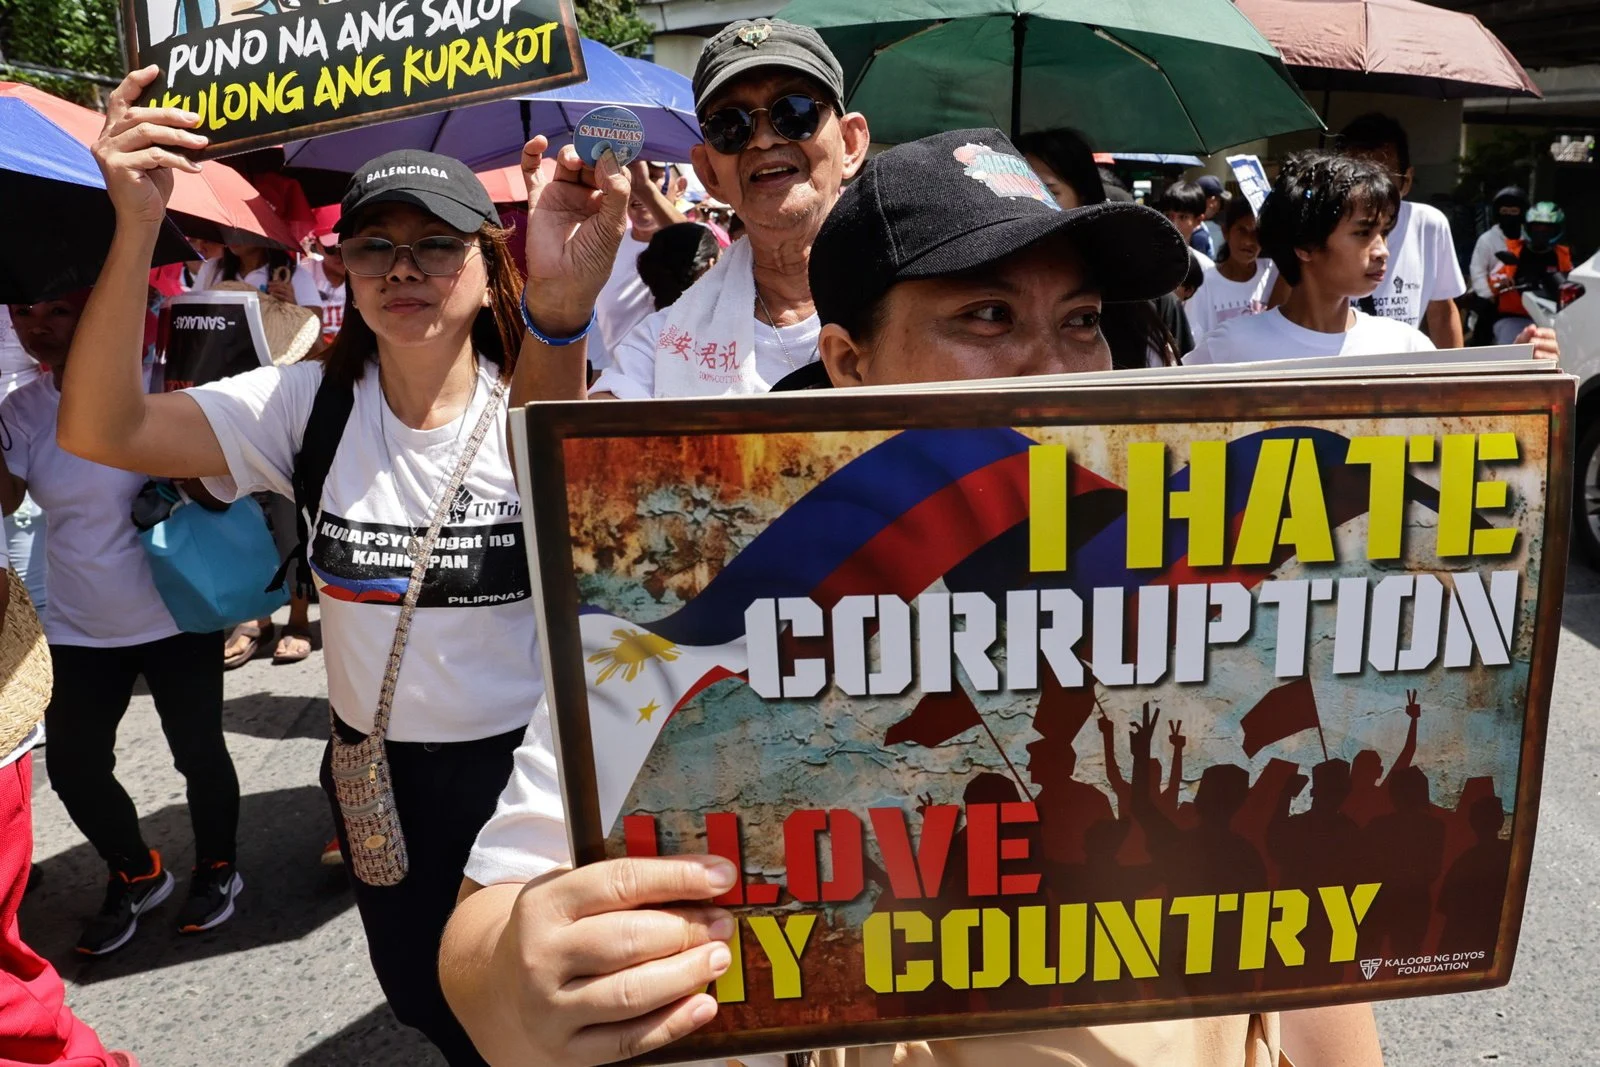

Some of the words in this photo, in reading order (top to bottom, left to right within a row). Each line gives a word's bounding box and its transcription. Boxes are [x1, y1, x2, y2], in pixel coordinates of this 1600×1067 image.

[166, 28, 268, 89] PUNO
[278, 16, 329, 64] NA
[336, 1, 414, 55] ANG
[313, 53, 391, 110] ANG
[403, 21, 559, 97] KURAKOT
[579, 124, 642, 142] SANLAKAS
[366, 165, 449, 183] BALENCIAGA
[473, 500, 522, 517] TNTri
[1029, 444, 1067, 572] I
[1126, 432, 1519, 569] HATE
[489, 533, 515, 548] ng
[448, 590, 525, 604] PILIPINAS
[744, 569, 1519, 699] CORRUPTION
[705, 801, 1042, 906] LOVE
[862, 882, 1382, 994] COUNTRY
[1384, 955, 1431, 967] KALOOB
[1433, 954, 1450, 963] NG
[1452, 951, 1485, 961] DIYOS
[1397, 961, 1470, 975] FOUNDATION
